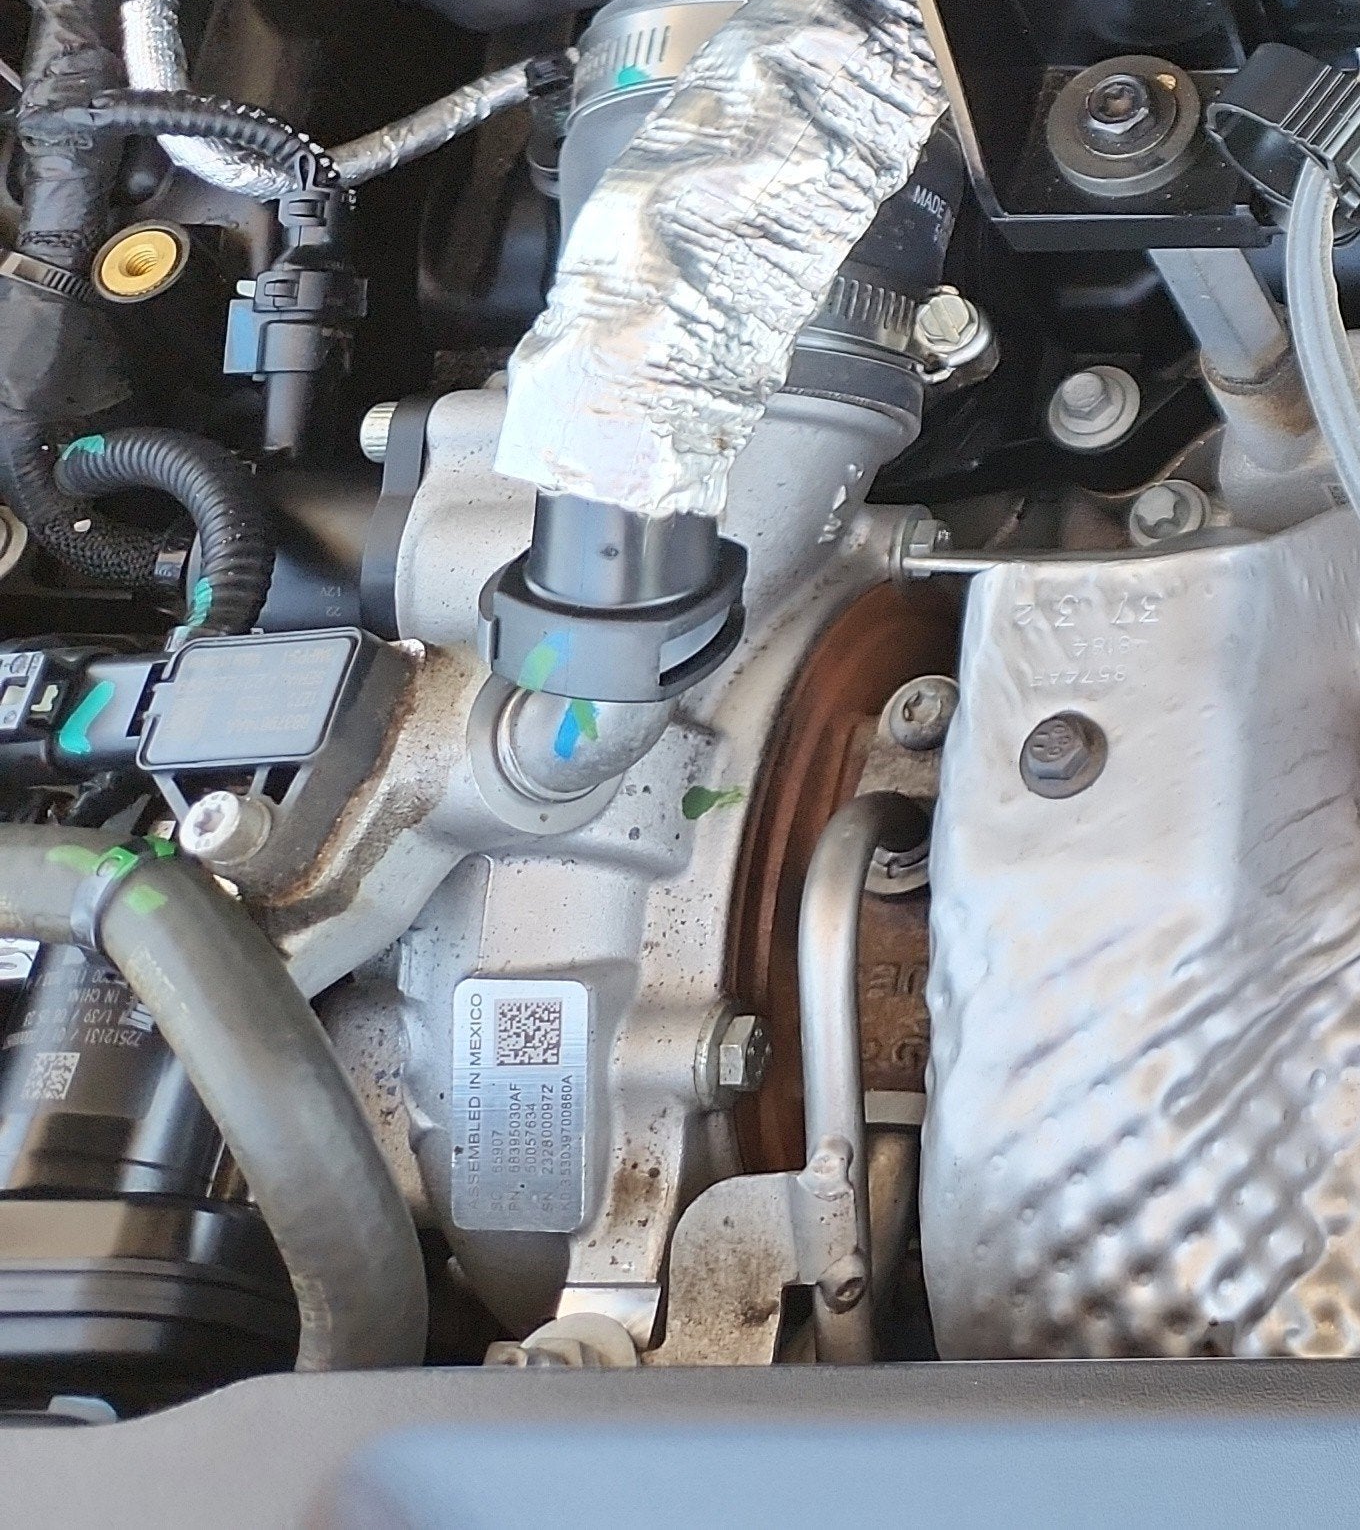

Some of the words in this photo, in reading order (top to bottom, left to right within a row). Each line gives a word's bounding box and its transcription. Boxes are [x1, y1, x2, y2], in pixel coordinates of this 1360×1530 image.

[913, 184, 947, 219] MADE
[470, 993, 483, 1066] MEXICO
[469, 1072, 480, 1089] IN
[468, 1096, 481, 1211] ASSEMBLED
